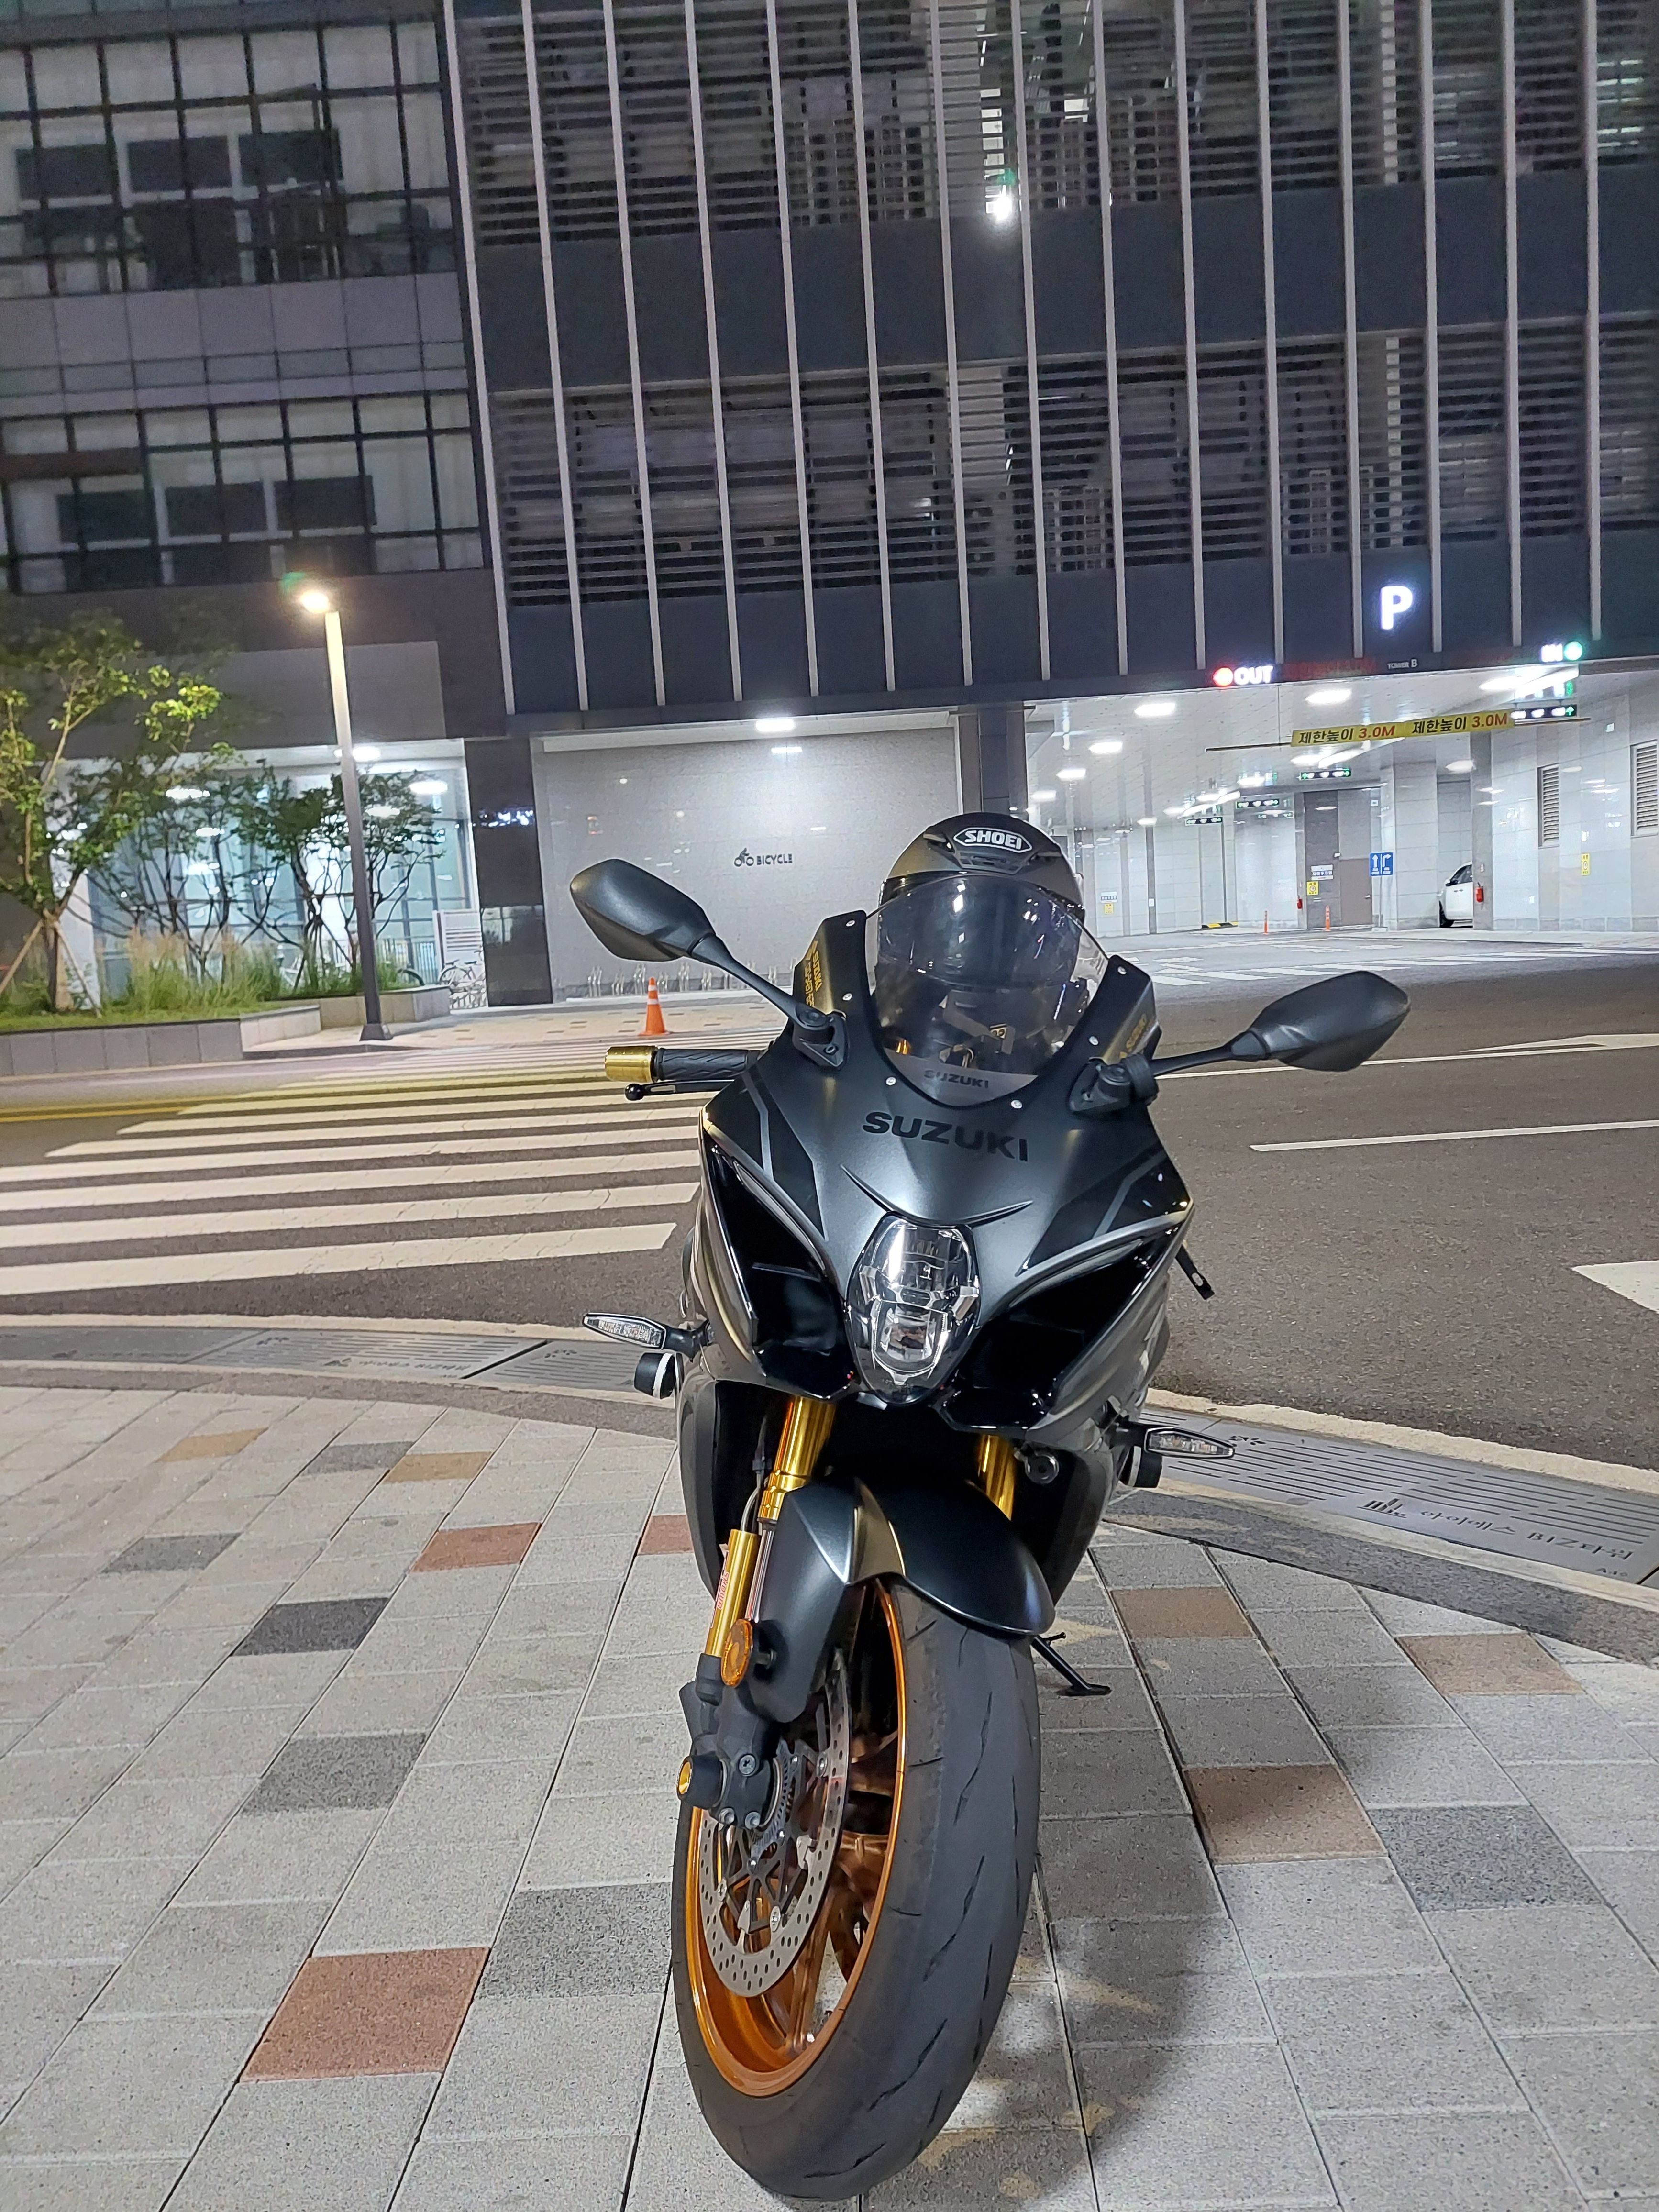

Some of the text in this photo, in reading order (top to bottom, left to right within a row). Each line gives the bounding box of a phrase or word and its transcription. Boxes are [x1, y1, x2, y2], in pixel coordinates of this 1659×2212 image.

[1380, 586, 1413, 630] P
[1411, 659, 1417, 668] B
[1234, 665, 1273, 685] OUT
[1411, 716, 1466, 734] 제한높이
[1471, 713, 1507, 728] 3.0M
[1298, 725, 1395, 744] 제한높이 3.0M
[964, 830, 1022, 850] SHOEI
[756, 853, 793, 865] BICYCLE
[924, 1070, 989, 1088] SUZUKI
[862, 1111, 1028, 1162] SUZUKI
